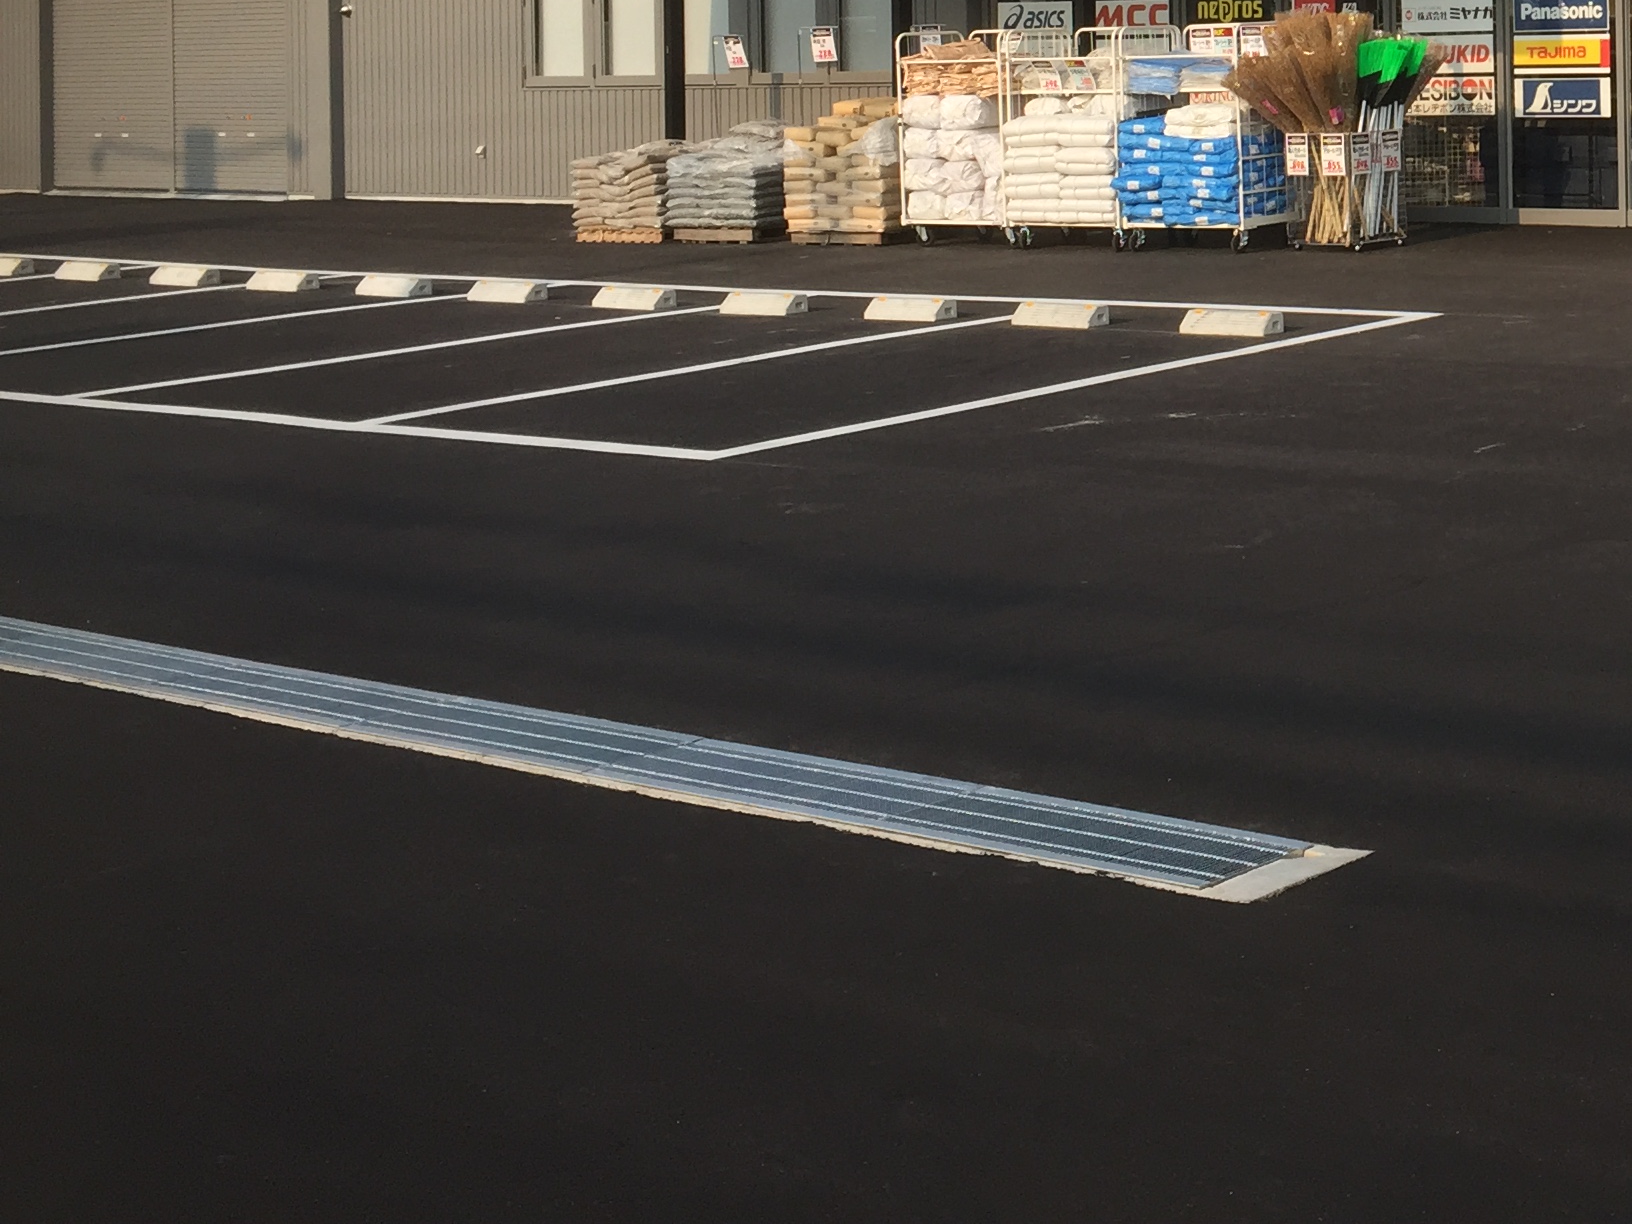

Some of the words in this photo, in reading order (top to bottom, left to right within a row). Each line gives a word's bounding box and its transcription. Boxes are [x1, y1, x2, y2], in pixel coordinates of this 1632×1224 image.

[1023, 10, 1066, 29] asics
[1096, 4, 1169, 26] MCC
[1520, 1, 1603, 21] Panasonic
[1418, 79, 1493, 101] ESIBON
[1552, 99, 1598, 113] シンワ
